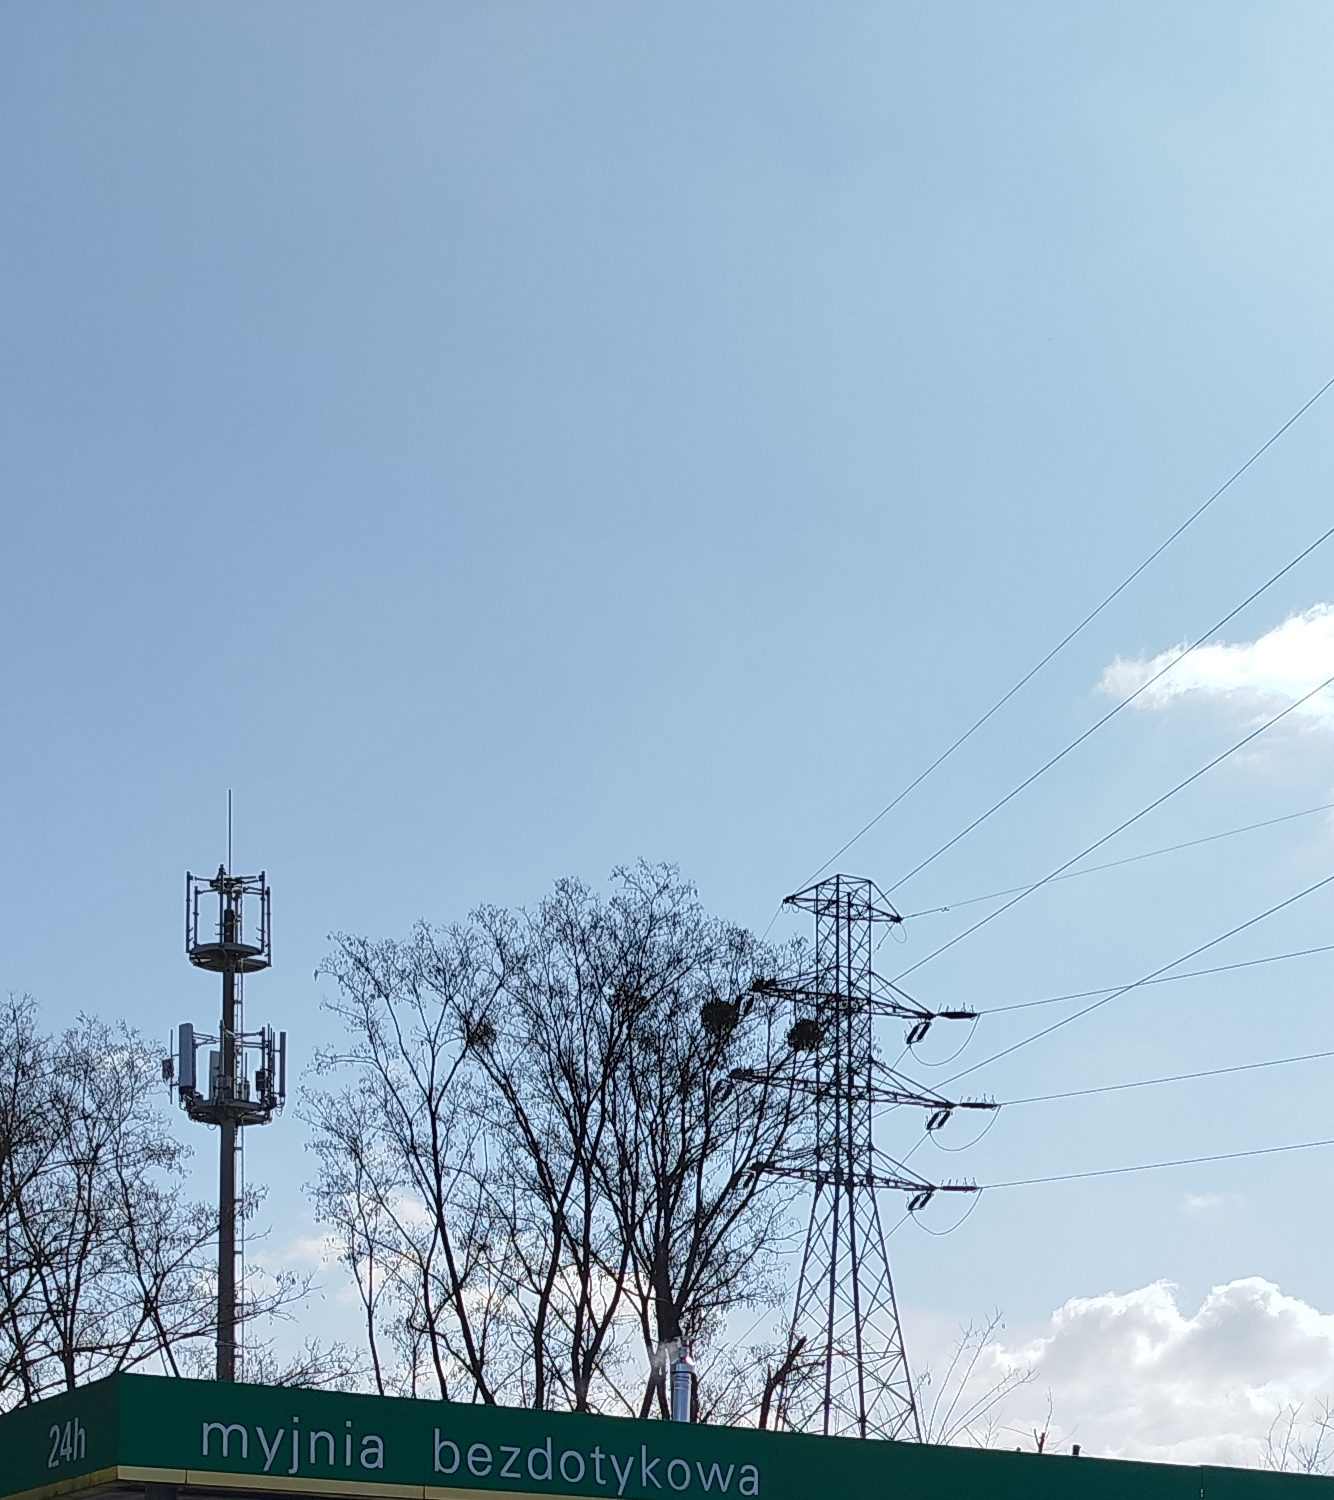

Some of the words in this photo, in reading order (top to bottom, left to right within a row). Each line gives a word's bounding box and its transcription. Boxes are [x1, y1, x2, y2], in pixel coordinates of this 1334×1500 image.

[48, 1417, 86, 1469] 24h
[201, 1416, 385, 1475] myjnia
[434, 1428, 761, 1497] bezdotykowa
